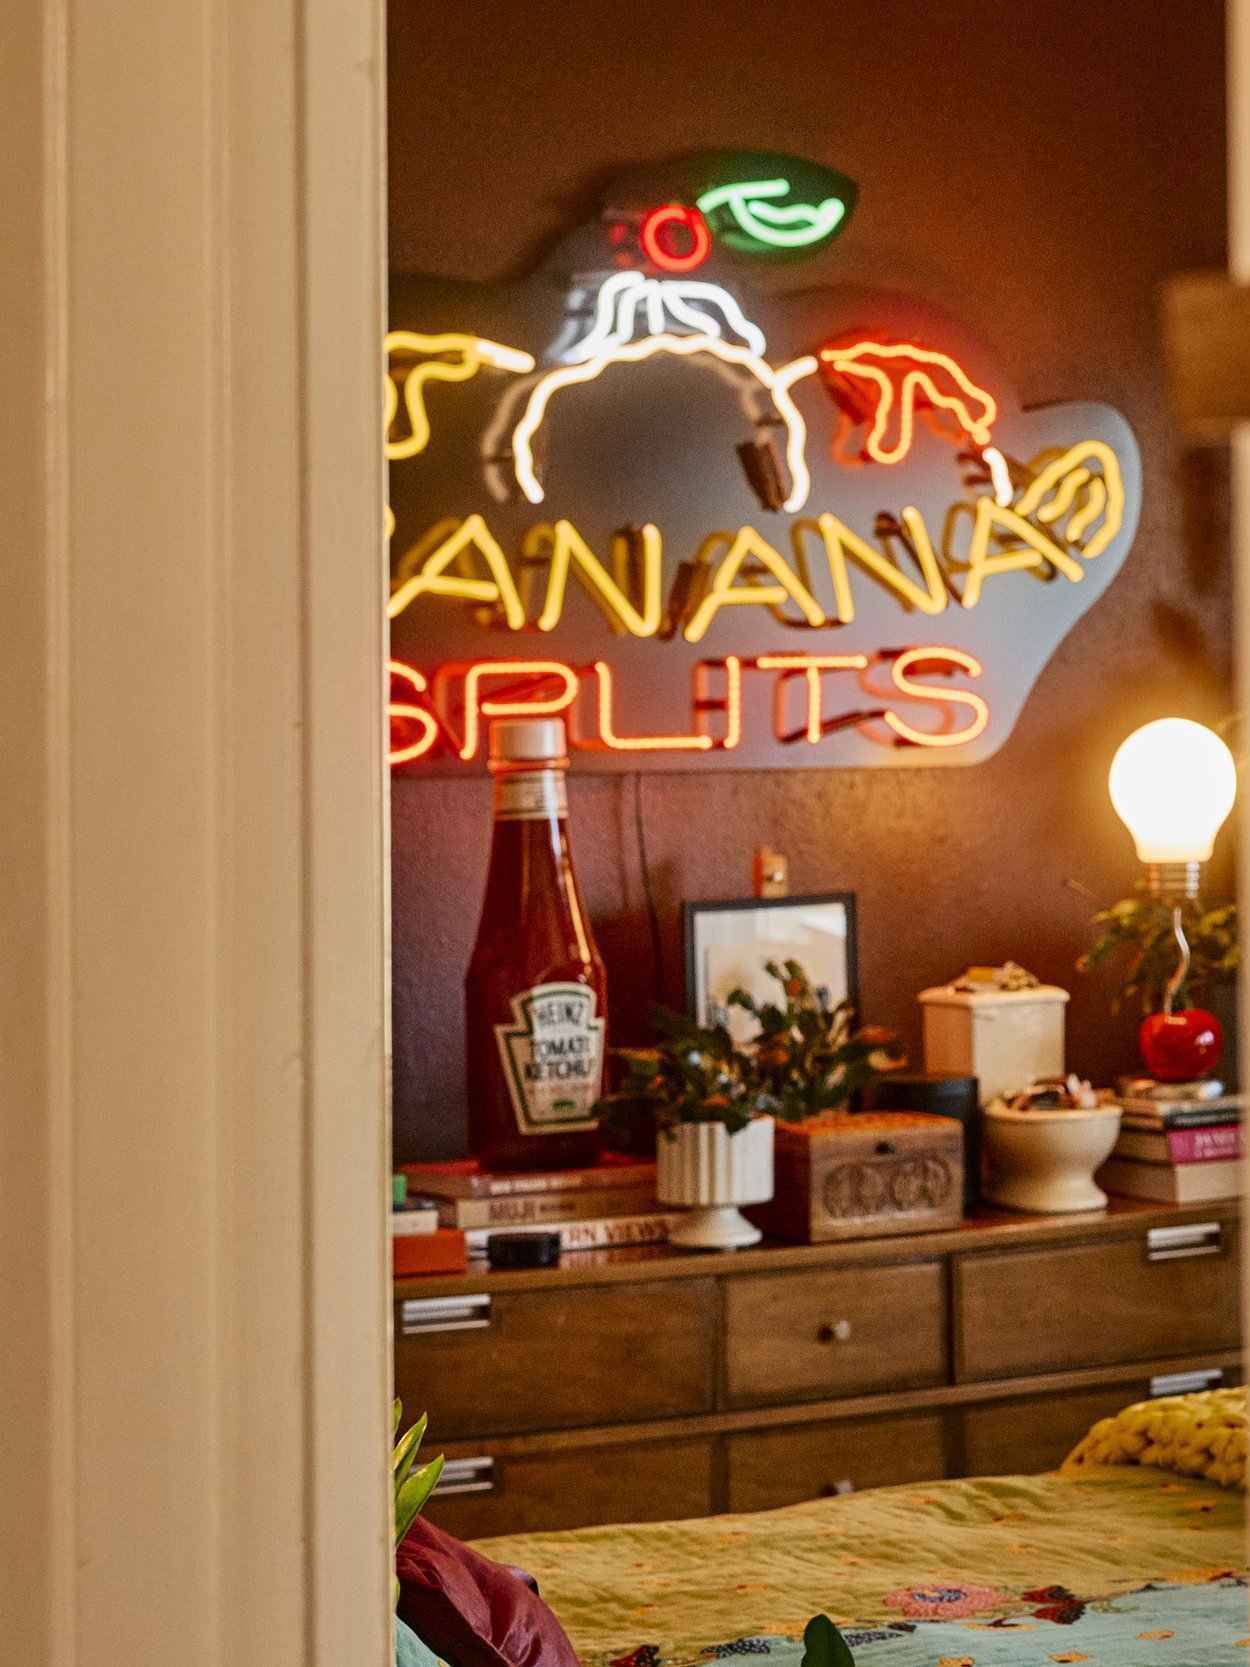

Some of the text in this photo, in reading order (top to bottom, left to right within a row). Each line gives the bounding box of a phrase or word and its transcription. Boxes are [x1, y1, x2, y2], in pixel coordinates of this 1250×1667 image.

[385, 497, 1085, 643] ANANA
[535, 1002, 585, 1028] HEINZ
[604, 1219, 670, 1242] VIEWS
